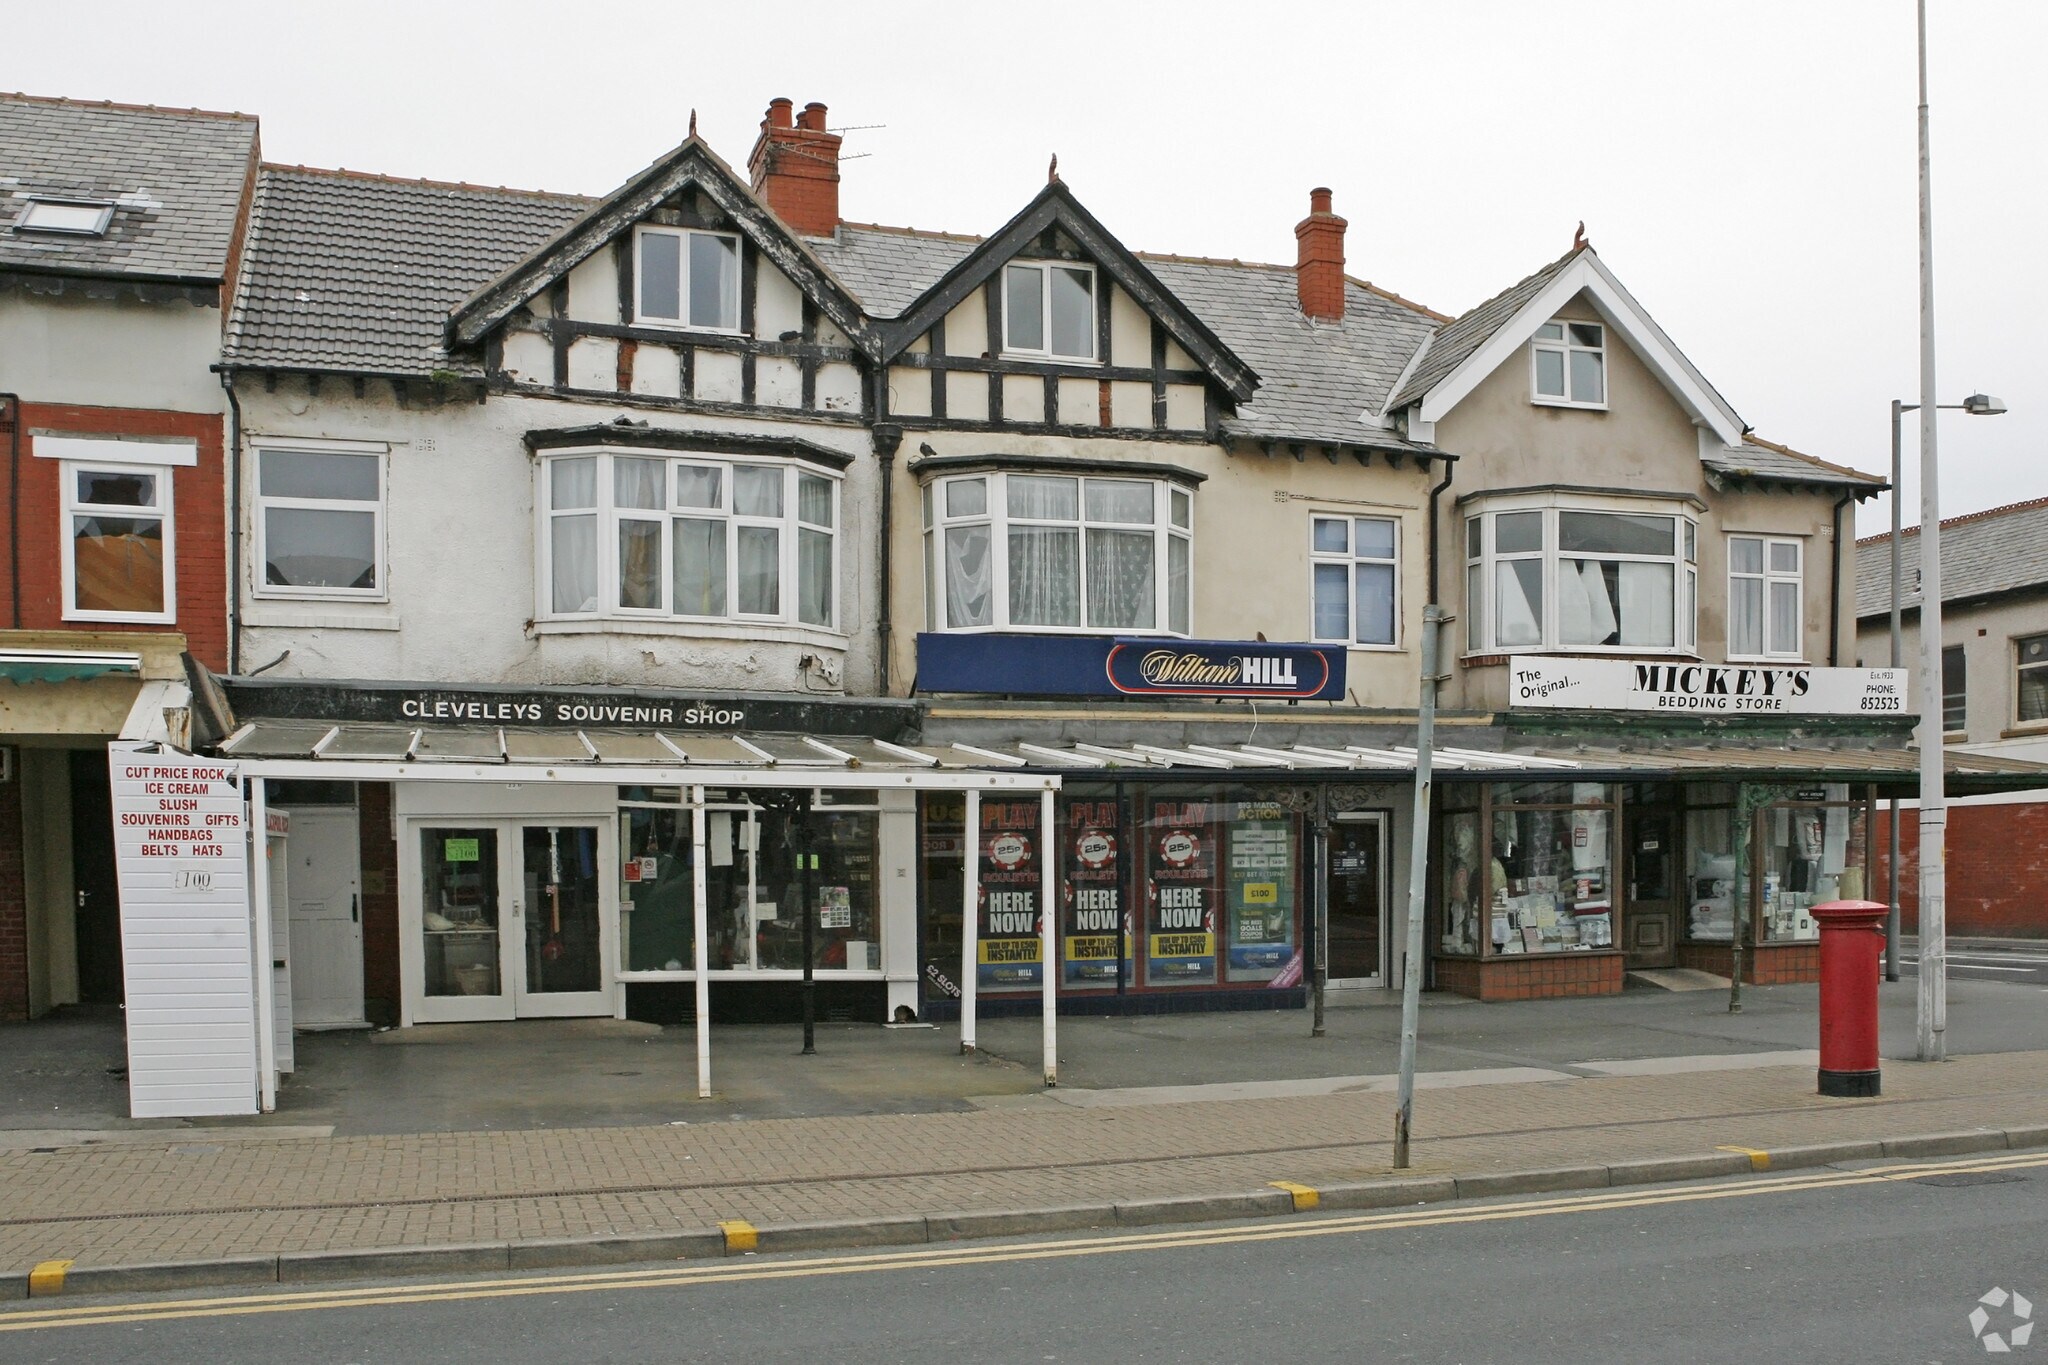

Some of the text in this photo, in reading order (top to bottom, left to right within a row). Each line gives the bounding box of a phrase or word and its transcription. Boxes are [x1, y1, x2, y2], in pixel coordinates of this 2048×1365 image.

[1140, 650, 1297, 685] William HILL
[1517, 670, 1542, 684] The
[1632, 664, 1810, 697] MICKEY'S
[1520, 676, 1580, 699] Original...
[1866, 684, 1896, 694] PHONE:
[1658, 695, 1782, 710] BEDDING STORE
[1860, 697, 1900, 710] 852525
[402, 700, 745, 725] CLEVELEYS SOUVENIR SHOP
[125, 767, 225, 780] CUT PRICE ROCK
[145, 783, 209, 795] ICE CREAM
[159, 799, 198, 810] SLUSH
[1237, 801, 1281, 809] BIG MATCH
[121, 814, 239, 826] SOUVENIRS GIFTS
[982, 804, 1039, 829] PLAY
[1155, 802, 1207, 828] PLAY
[1237, 809, 1281, 820] ACTION
[148, 829, 213, 840] HANDBAGS
[141, 845, 223, 856] BELTS HATS
[982, 873, 1040, 883] ROULETTE
[1155, 868, 1208, 879] ROULETTE
[989, 892, 1034, 912] HERE
[1077, 889, 1117, 910] HERE
[1161, 887, 1202, 908] HERE
[990, 912, 1034, 933] NOW
[1077, 910, 1117, 930] NOW
[1161, 908, 1202, 928] NOW
[987, 948, 1037, 961] INSTANTLY
[1074, 945, 1117, 958] INSTANTL
[1158, 942, 1206, 955] INSTANTLY
[1018, 969, 1033, 977] HILL
[1104, 965, 1118, 973] HILL
[937, 974, 962, 998] SLOTS
